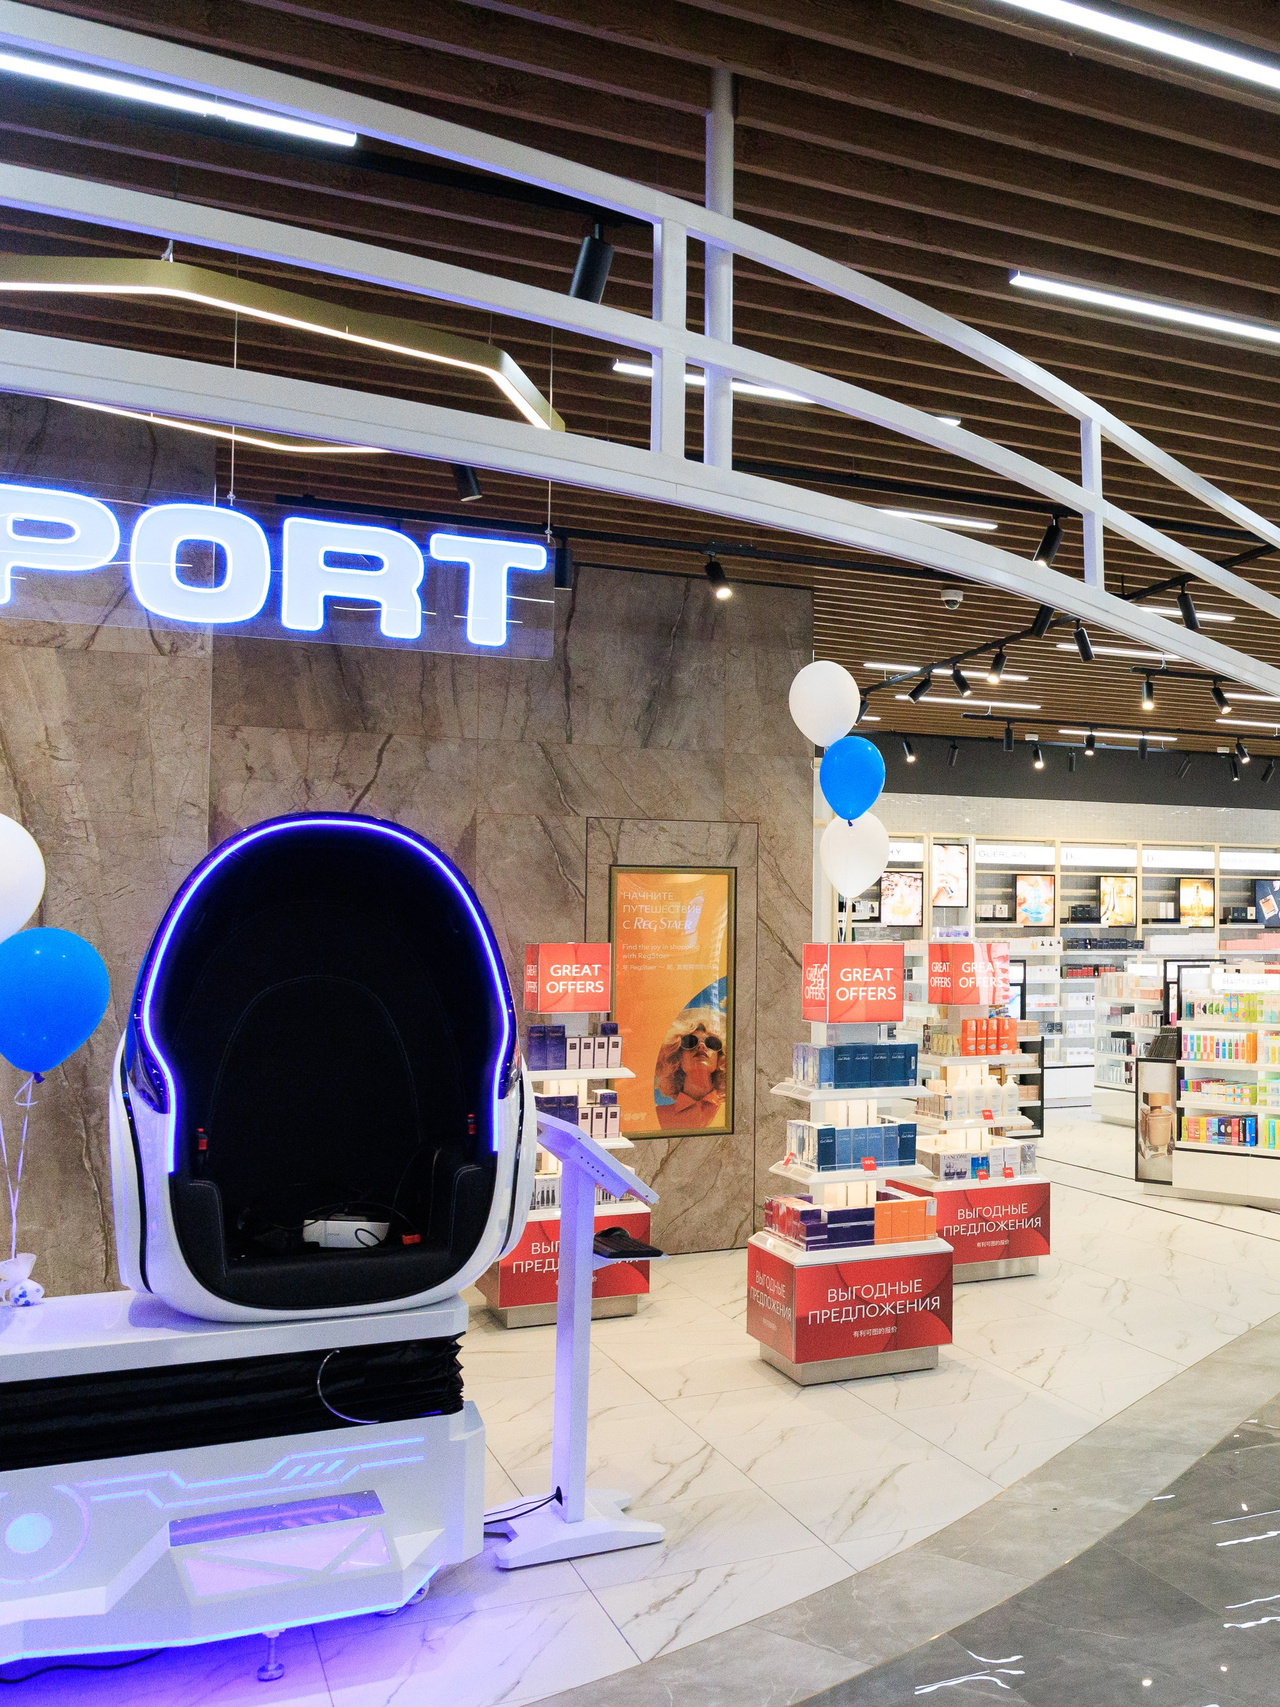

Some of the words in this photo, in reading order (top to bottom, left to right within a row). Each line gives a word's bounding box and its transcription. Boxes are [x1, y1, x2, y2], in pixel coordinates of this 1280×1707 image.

[0, 482, 548, 647] PORT
[623, 891, 674, 901] НАЧНИТЕ
[623, 904, 702, 914] ПУТЕШЕСТВИЕ
[550, 964, 602, 977] GREAT
[931, 962, 950, 973] GREAT
[962, 962, 1001, 973] GREAT
[840, 967, 894, 982] GREAT
[546, 981, 604, 994] OFFERS
[930, 977, 952, 988] OFFERS
[959, 977, 1004, 988] OFFERS
[836, 987, 897, 1001] OFFERS
[957, 1203, 1028, 1220] ВЫГОДНЫЕ
[943, 1217, 1042, 1237] ПРЕДЛОЖЕНИЯ
[756, 1270, 786, 1299] ВЫГОДНЫЕ
[827, 1279, 923, 1303] ВЫГОДНЫЕ
[750, 1286, 792, 1322] ПРЕДЛОЖЕНИЯ
[808, 1296, 941, 1325] ПРЕДЛОЖЕНИЯ
[853, 1326, 898, 1338] 有利可图的报价
